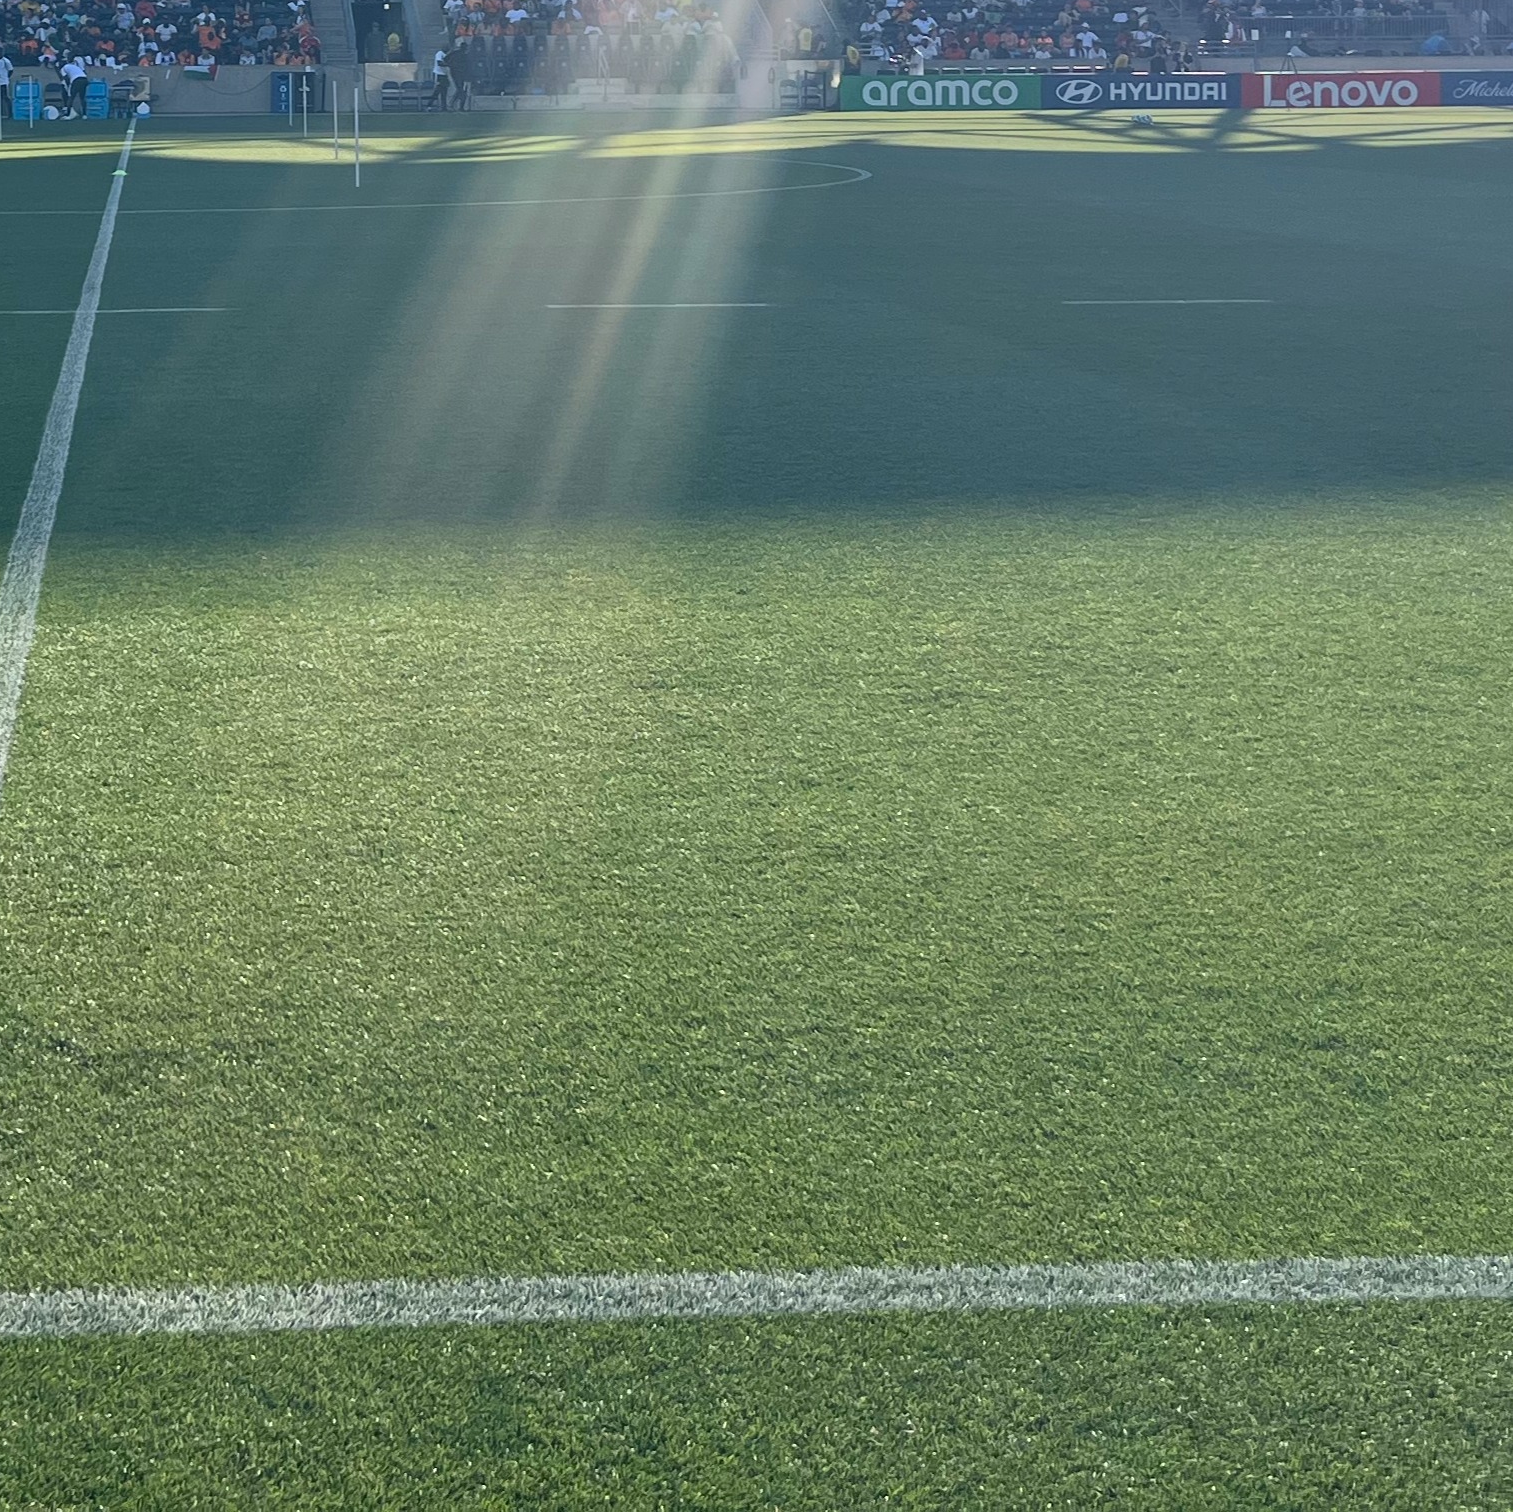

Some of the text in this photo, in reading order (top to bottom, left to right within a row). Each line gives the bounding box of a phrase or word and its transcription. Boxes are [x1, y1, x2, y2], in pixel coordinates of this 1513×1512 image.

[862, 79, 1018, 107] aramco
[1109, 81, 1227, 101] HYUNDAI
[1263, 74, 1418, 107] Lenovo
